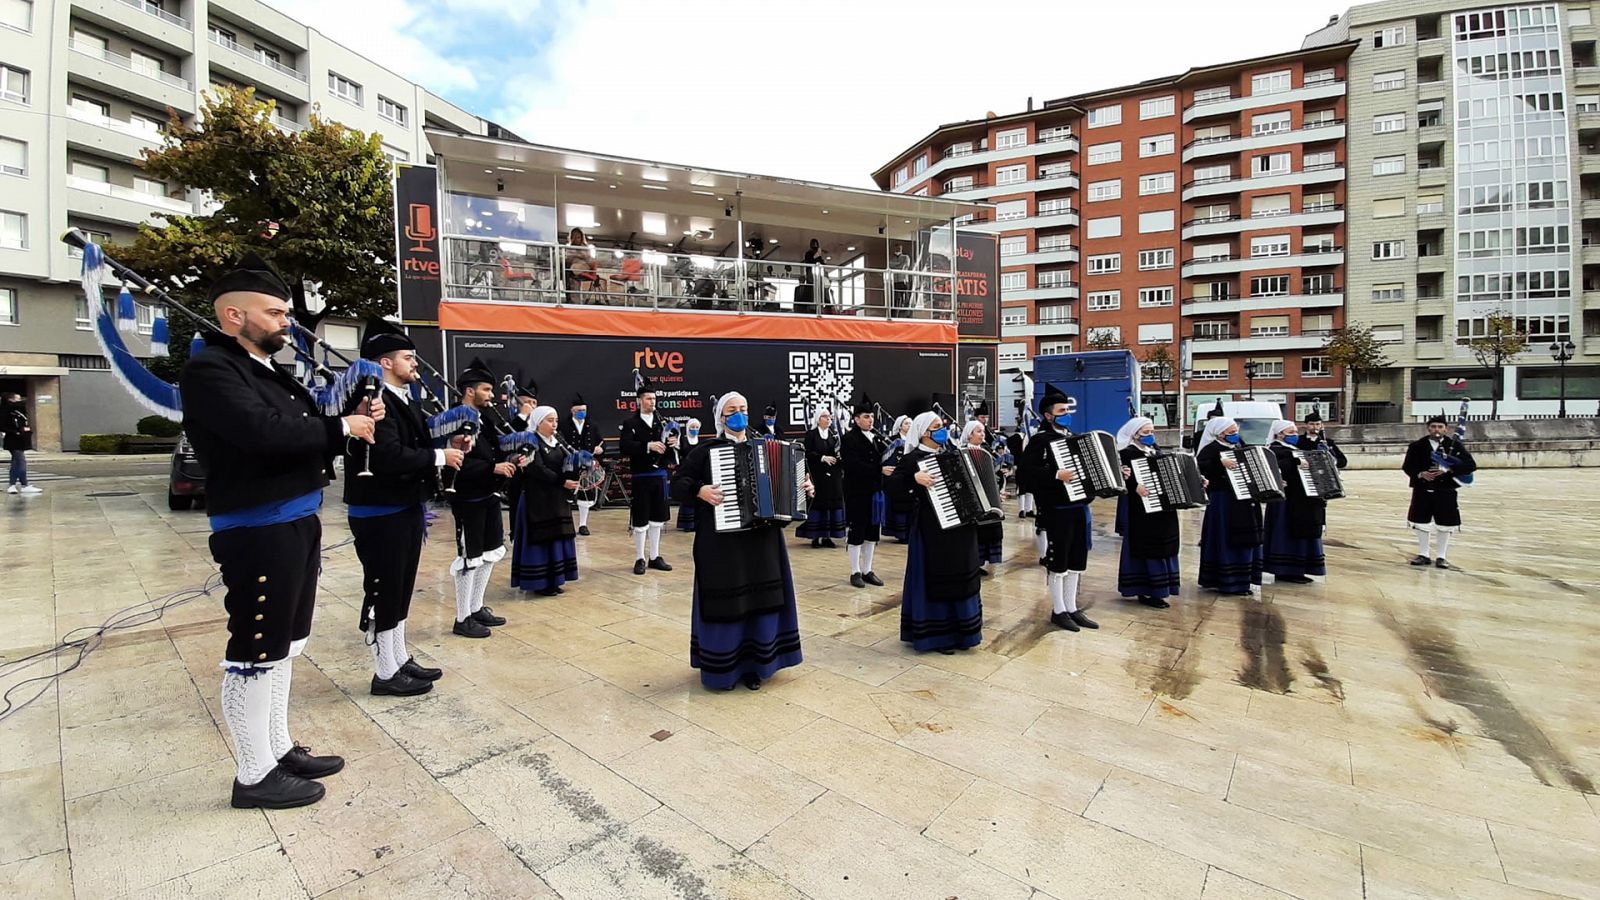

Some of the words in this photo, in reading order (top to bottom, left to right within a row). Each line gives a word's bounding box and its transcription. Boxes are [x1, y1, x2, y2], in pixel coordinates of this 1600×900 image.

[404, 257, 439, 275] rtve
[933, 277, 987, 296] GRATIS
[634, 347, 684, 373] rtve
[660, 375, 684, 383] quieres
[616, 399, 628, 410] la
[657, 399, 702, 409] consulta
